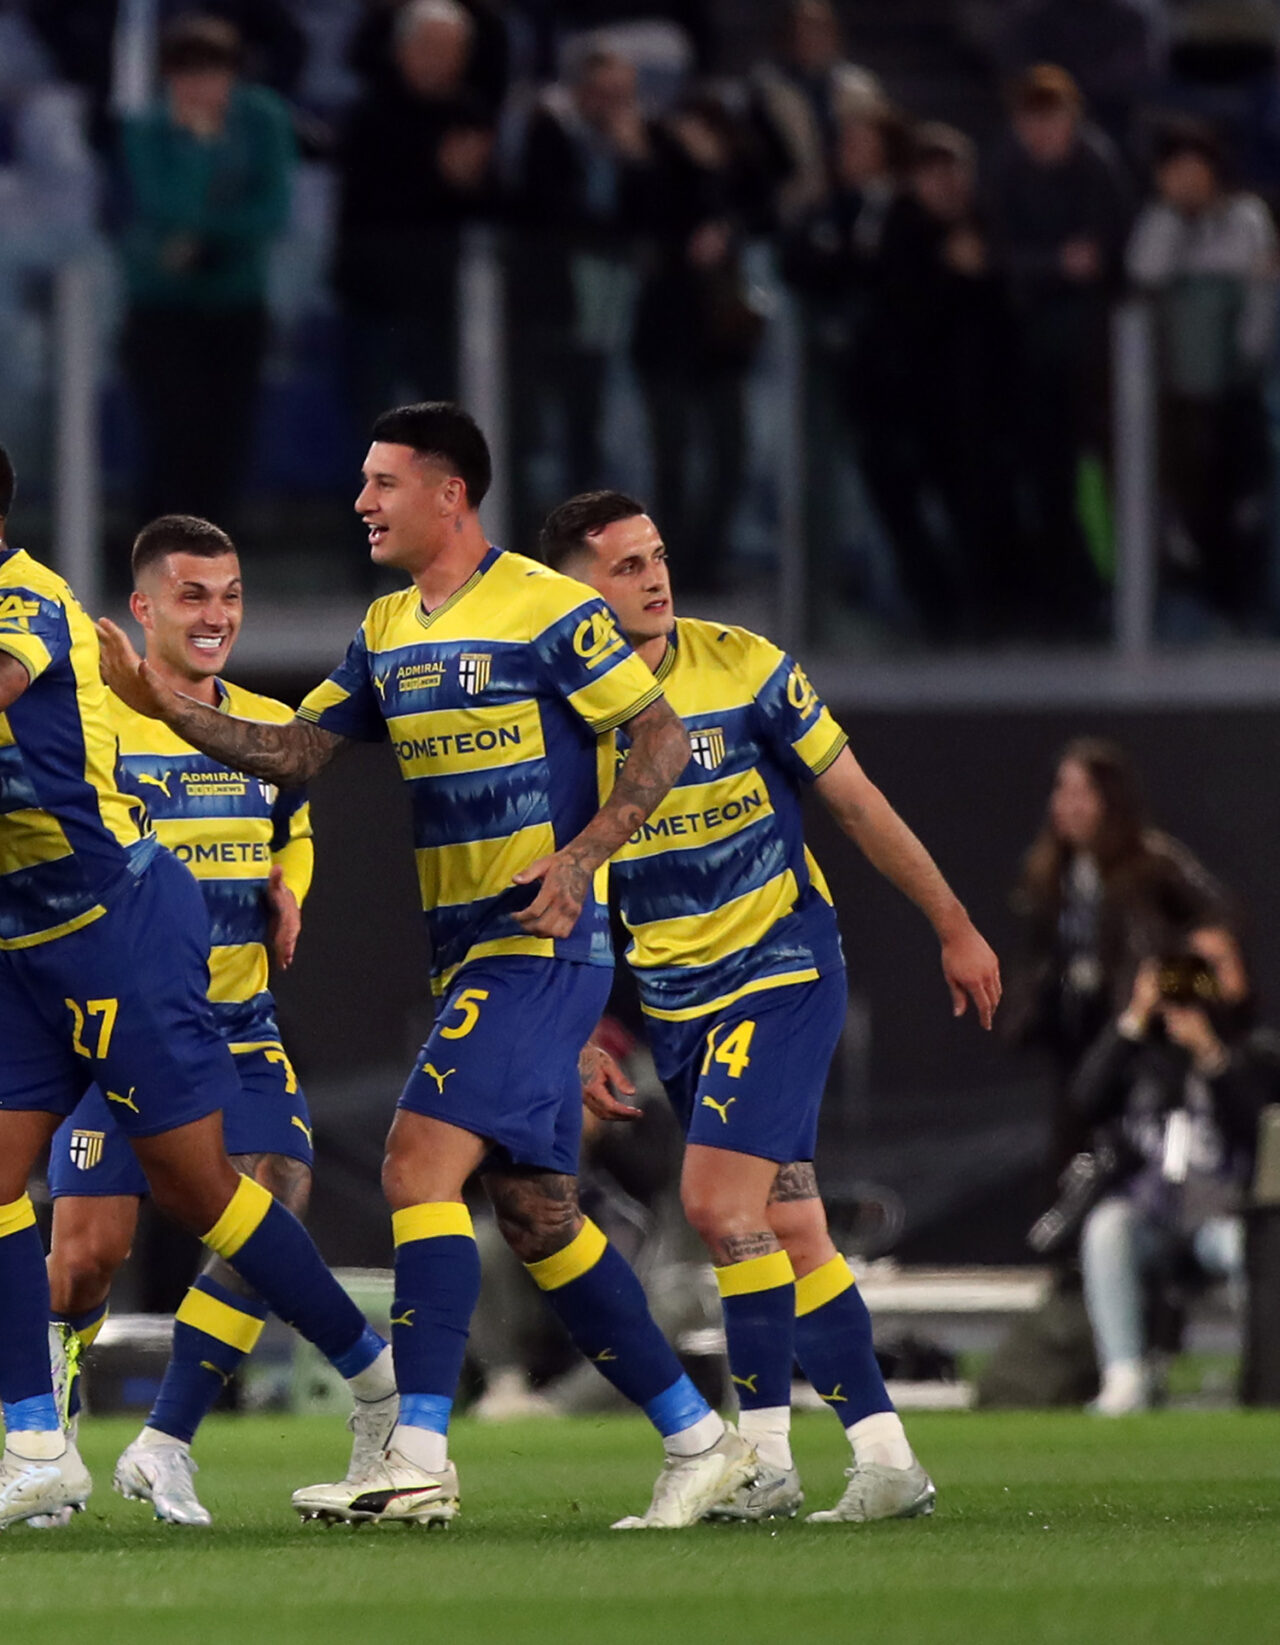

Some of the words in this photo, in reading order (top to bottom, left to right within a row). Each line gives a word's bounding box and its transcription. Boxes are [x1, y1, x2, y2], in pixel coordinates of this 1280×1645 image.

[396, 661, 447, 679] ADMIRAL
[180, 772, 250, 783] ADMIRAL
[65, 997, 119, 1060] 27
[440, 988, 489, 1039] 5
[701, 1020, 756, 1078] 14
